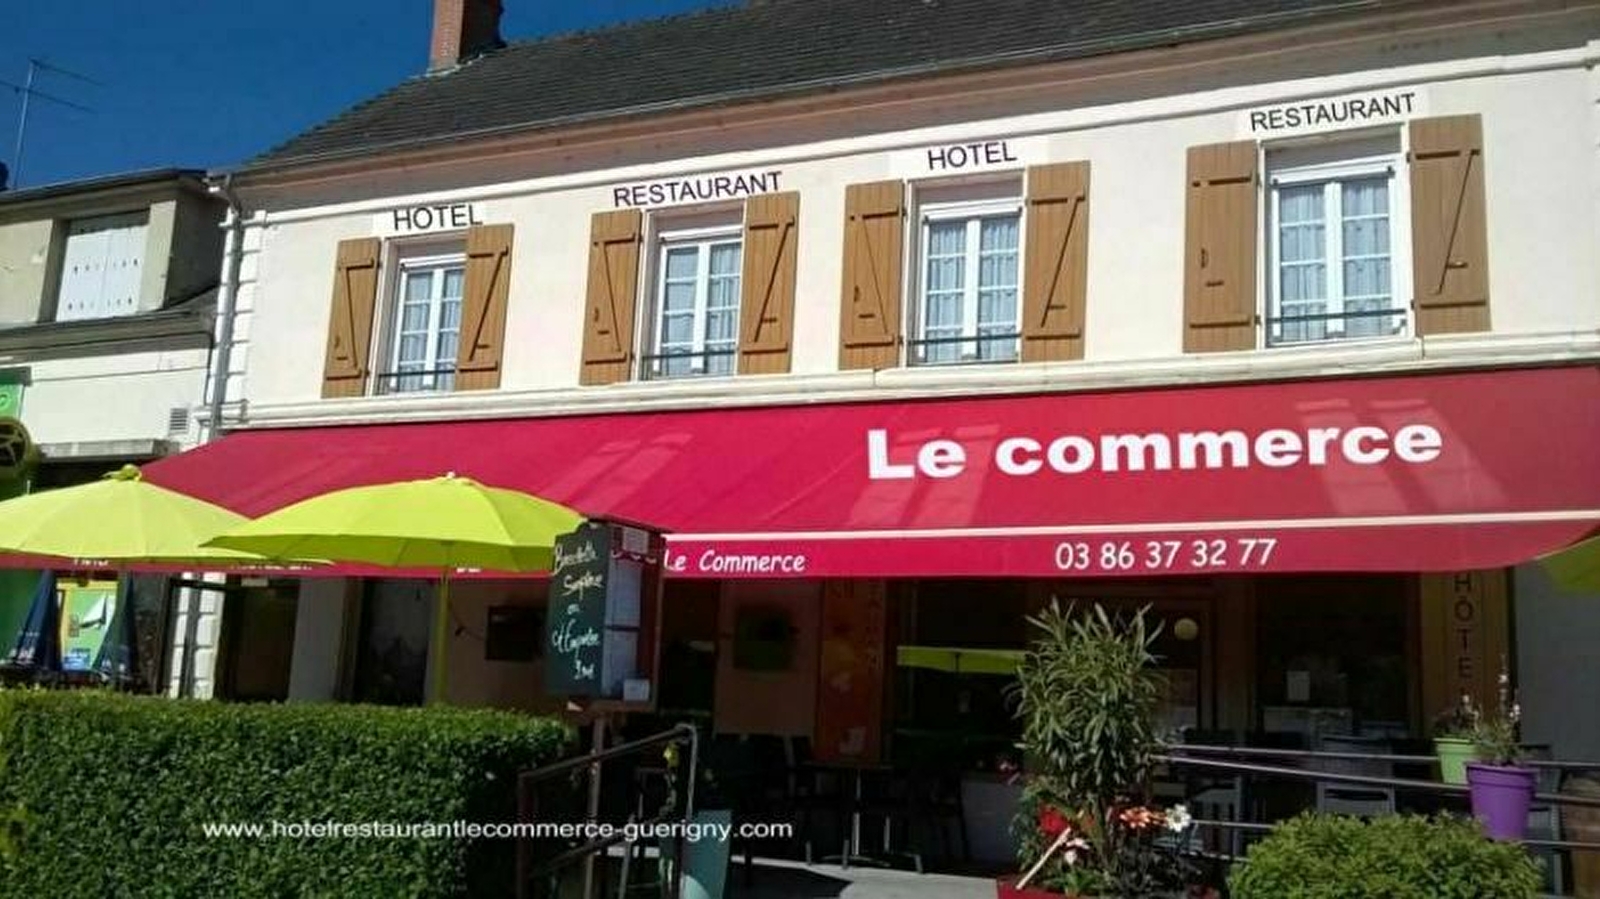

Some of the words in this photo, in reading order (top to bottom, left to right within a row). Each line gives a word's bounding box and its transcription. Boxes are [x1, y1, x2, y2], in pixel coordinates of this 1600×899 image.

[1251, 92, 1417, 131] RESTAURANT
[927, 140, 1018, 171] HOTEL
[613, 171, 783, 207] RESTAURANT
[393, 203, 483, 231] HOTEL
[867, 429, 966, 480] Le
[995, 424, 1443, 476] commerce
[663, 549, 687, 571] Le
[699, 549, 806, 573] Commerce
[1055, 542, 1090, 570] 03
[1100, 542, 1135, 570] 86
[1145, 540, 1182, 568] 37
[1191, 539, 1227, 567] 32
[1238, 538, 1277, 565] 77
